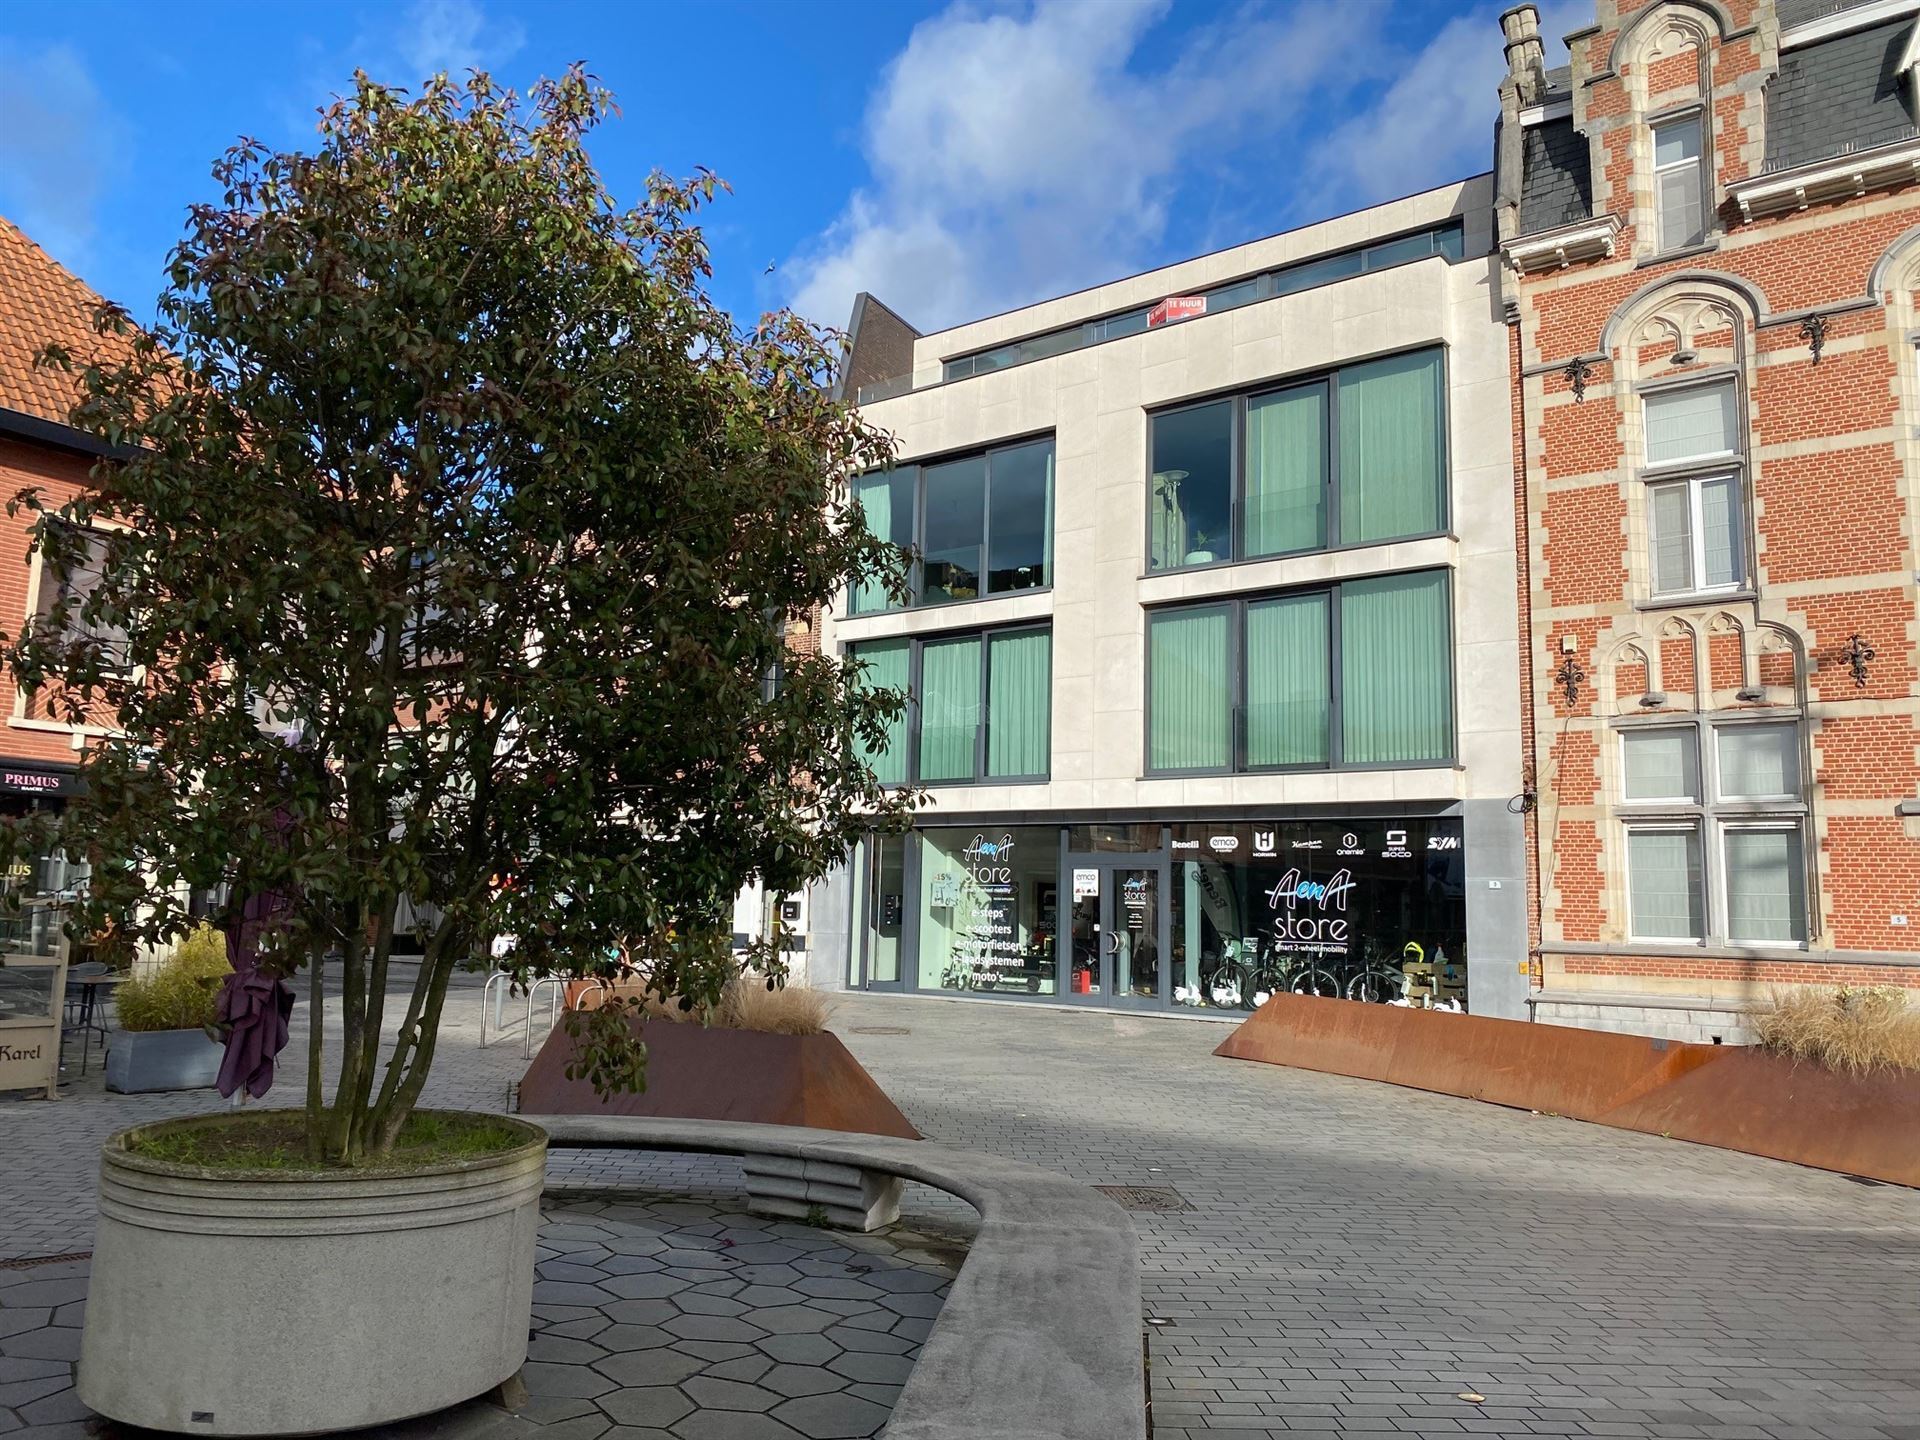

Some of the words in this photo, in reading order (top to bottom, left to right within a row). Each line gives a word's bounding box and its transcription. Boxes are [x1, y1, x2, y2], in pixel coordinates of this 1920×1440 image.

[1180, 299, 1202, 308] HUUR
[5, 774, 59, 788] PRIMUS
[1172, 840, 1199, 848] Benelli
[1427, 837, 1461, 850] SYM
[965, 862, 1011, 884] store
[1076, 873, 1096, 881] emco
[1124, 891, 1146, 900] store
[971, 908, 1003, 919] e-steps
[966, 924, 1012, 935] e-scooters
[1274, 911, 1348, 941] store
[972, 971, 1003, 981] moto's
[0, 1044, 41, 1061] Karel
